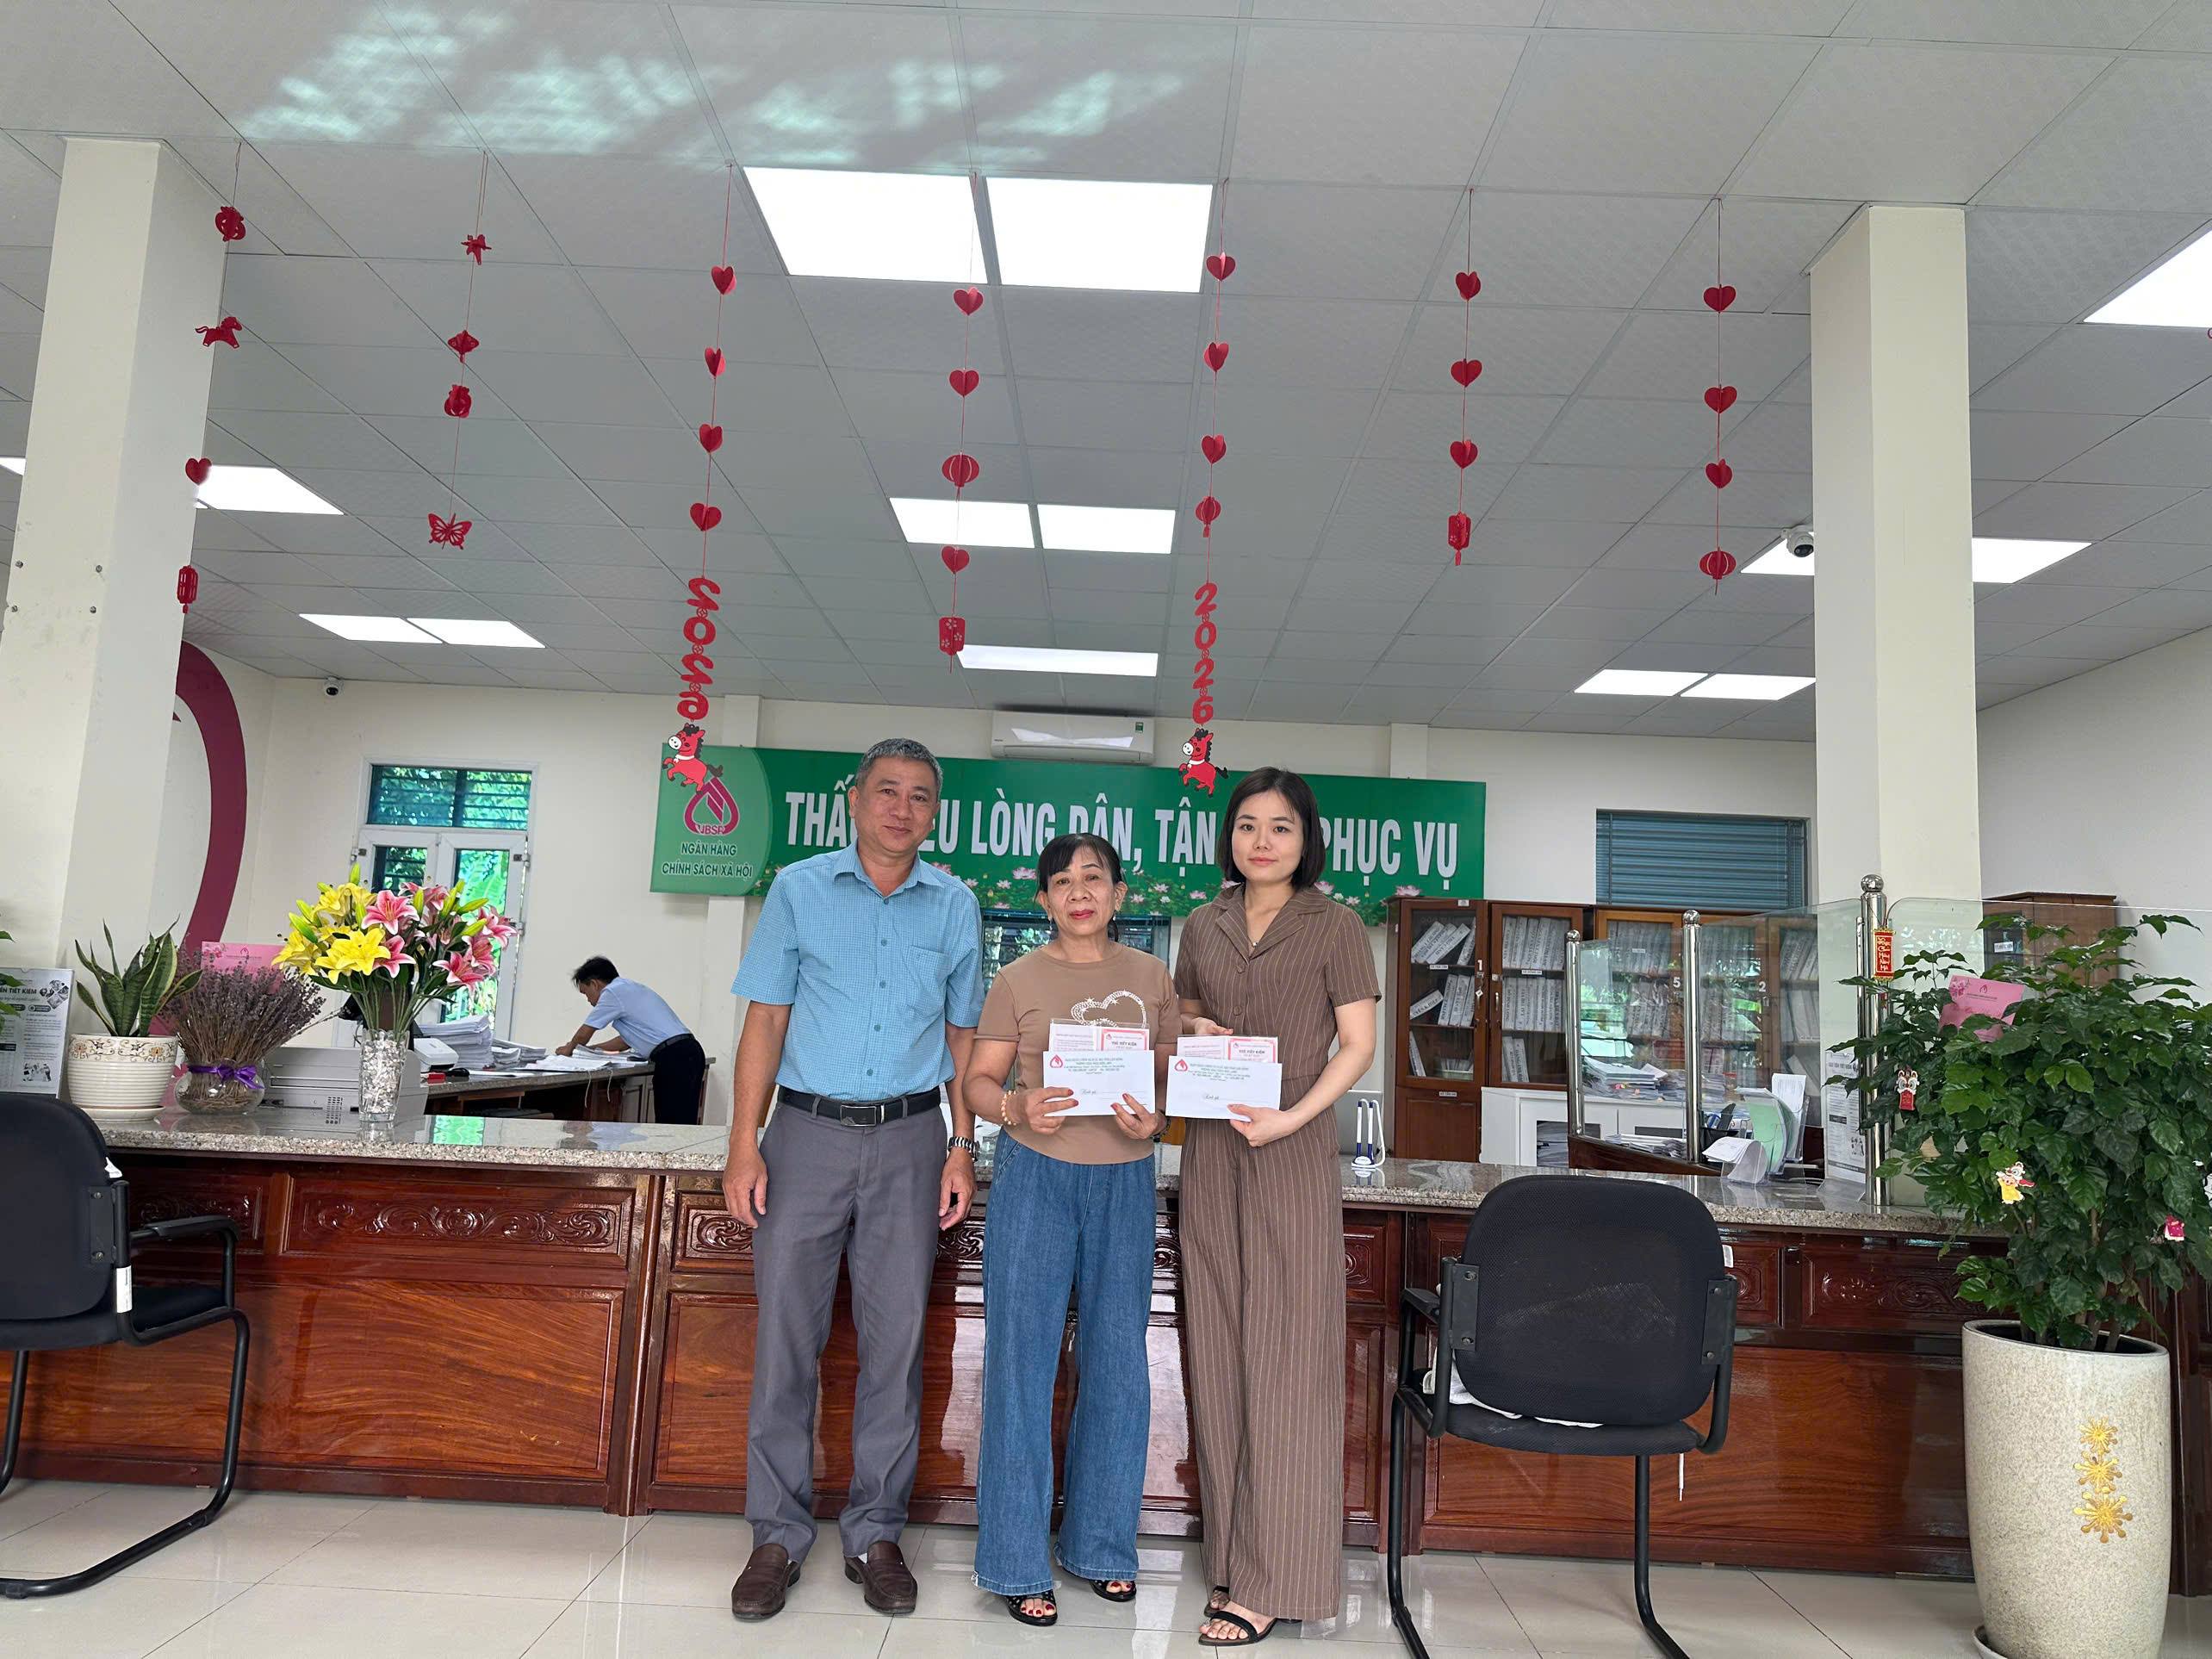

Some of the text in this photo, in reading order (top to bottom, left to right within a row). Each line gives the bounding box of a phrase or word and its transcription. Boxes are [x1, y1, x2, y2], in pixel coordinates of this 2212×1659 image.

[1192, 582, 1218, 724] 2026
[786, 774, 858, 848] THẤ
[971, 788, 1056, 856] LÒNG
[1155, 797, 1216, 877] TẬN
[1414, 821, 1457, 891] VỤ
[681, 840, 736, 856] NGÂN HÀNG
[662, 860, 753, 881] CHÍNH SÁCH XÃ HỘI
[1673, 977, 1681, 988] 5
[1758, 981, 1767, 992] 2
